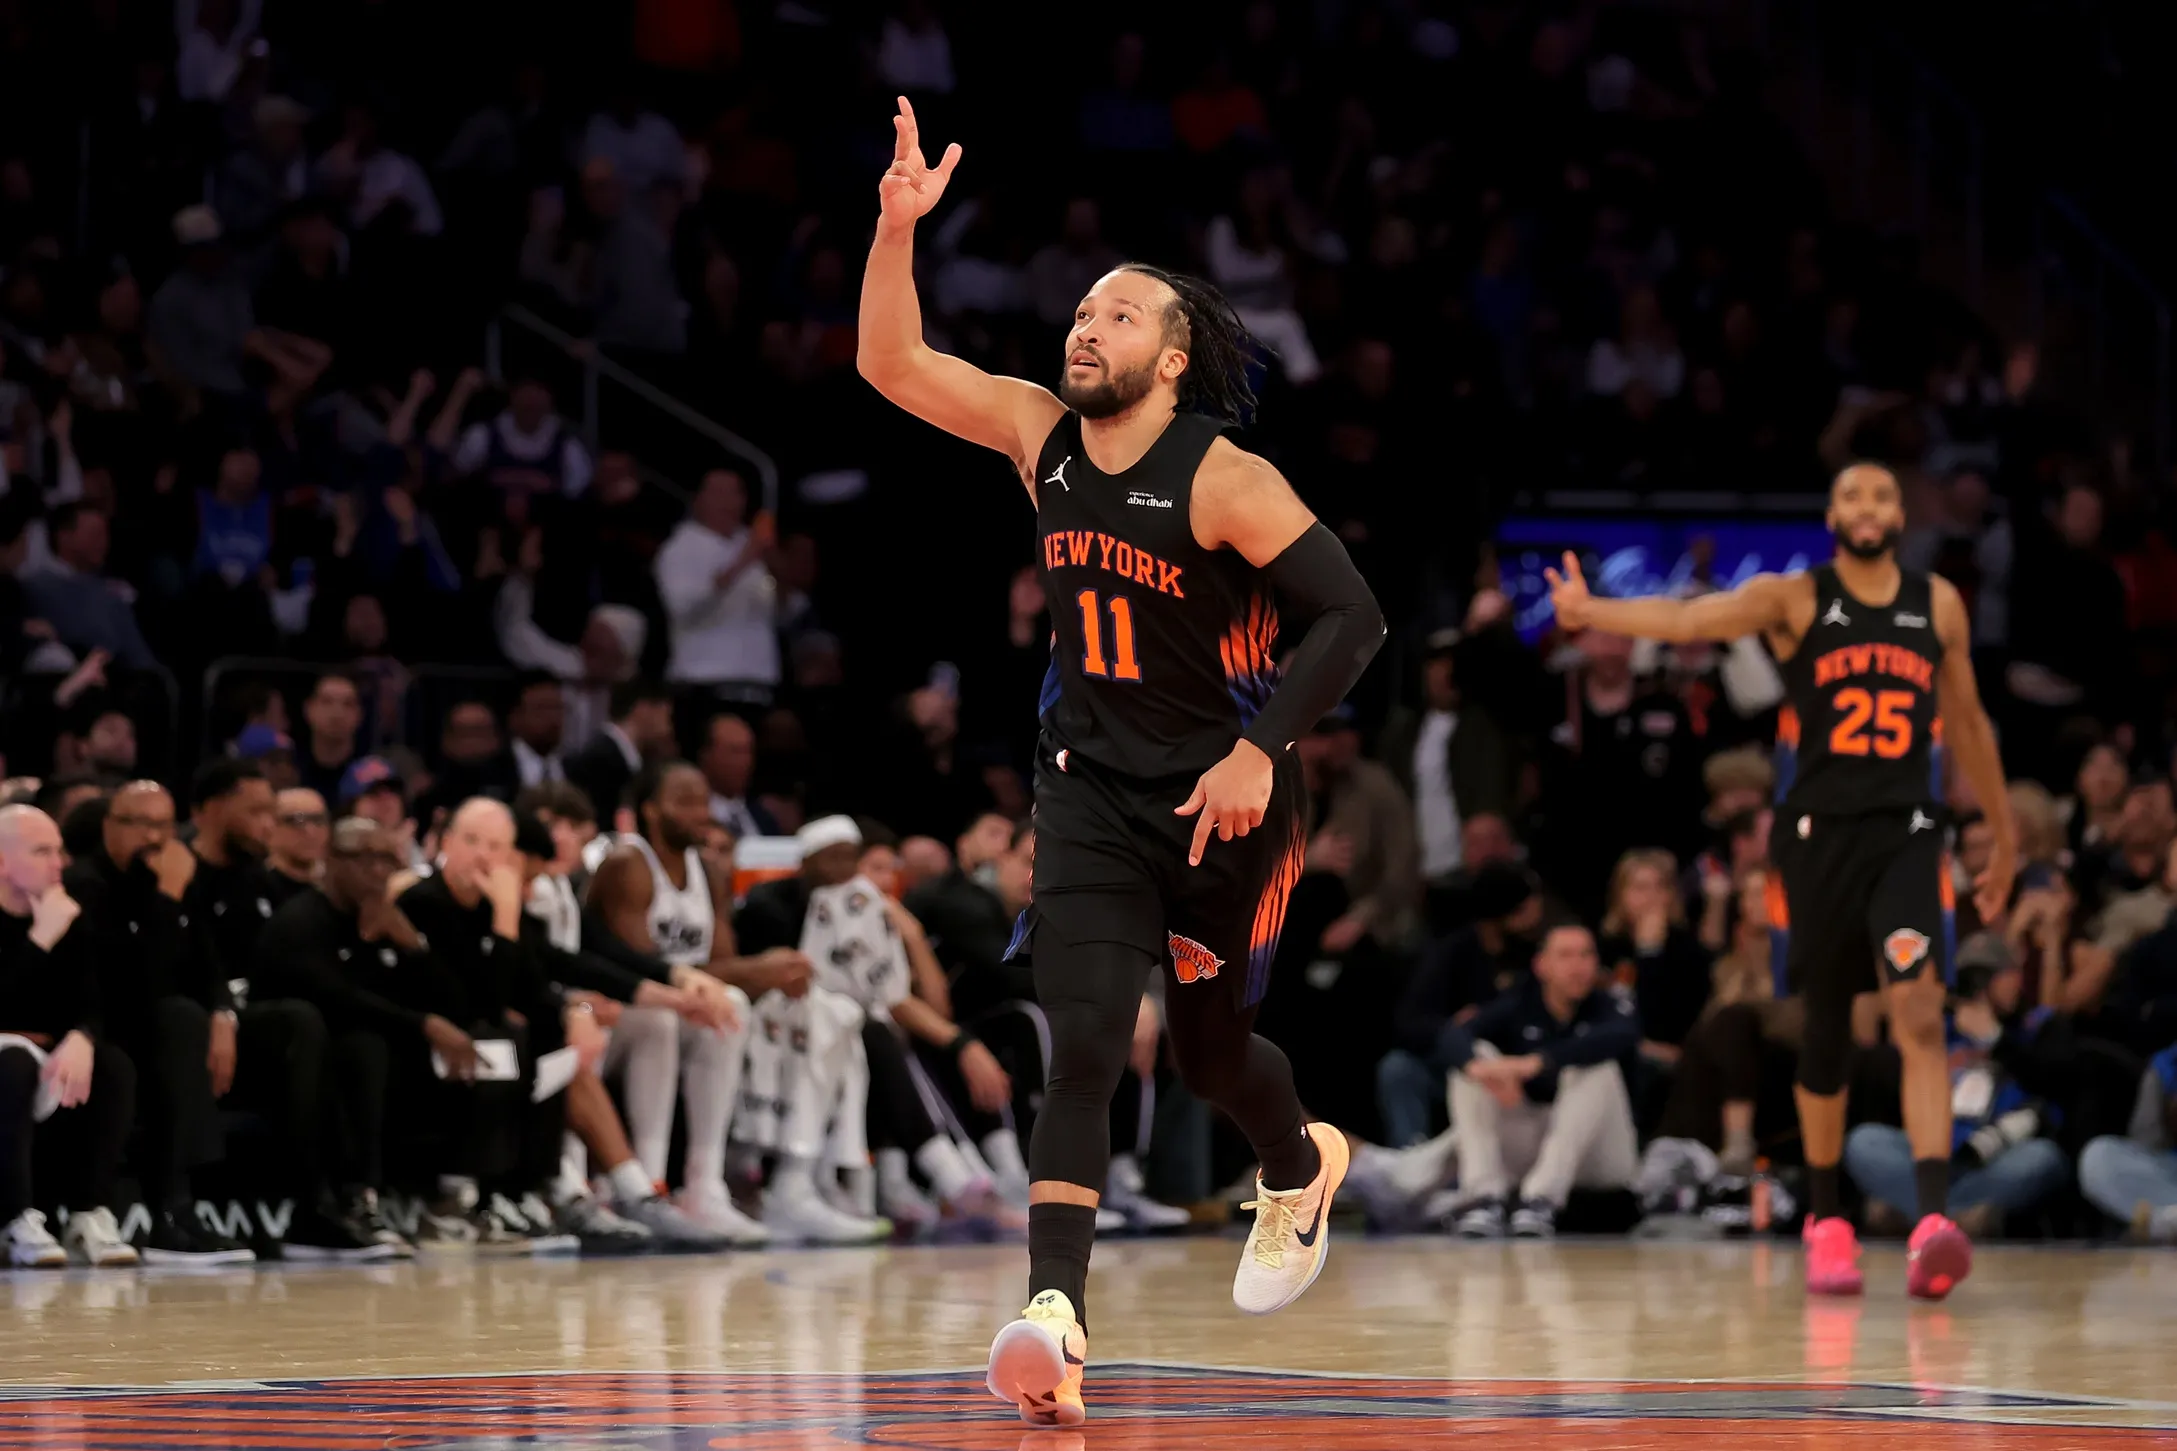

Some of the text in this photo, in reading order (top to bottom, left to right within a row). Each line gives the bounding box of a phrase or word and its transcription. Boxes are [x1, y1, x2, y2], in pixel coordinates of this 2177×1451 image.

[1127, 496, 1173, 508] abu dhabi
[1044, 531, 1185, 599] NEW YORK
[1076, 586, 1143, 684] 11
[1814, 642, 1933, 694] NEW YORK
[1830, 687, 1916, 759] 25
[1169, 936, 1216, 975] KNICKS
